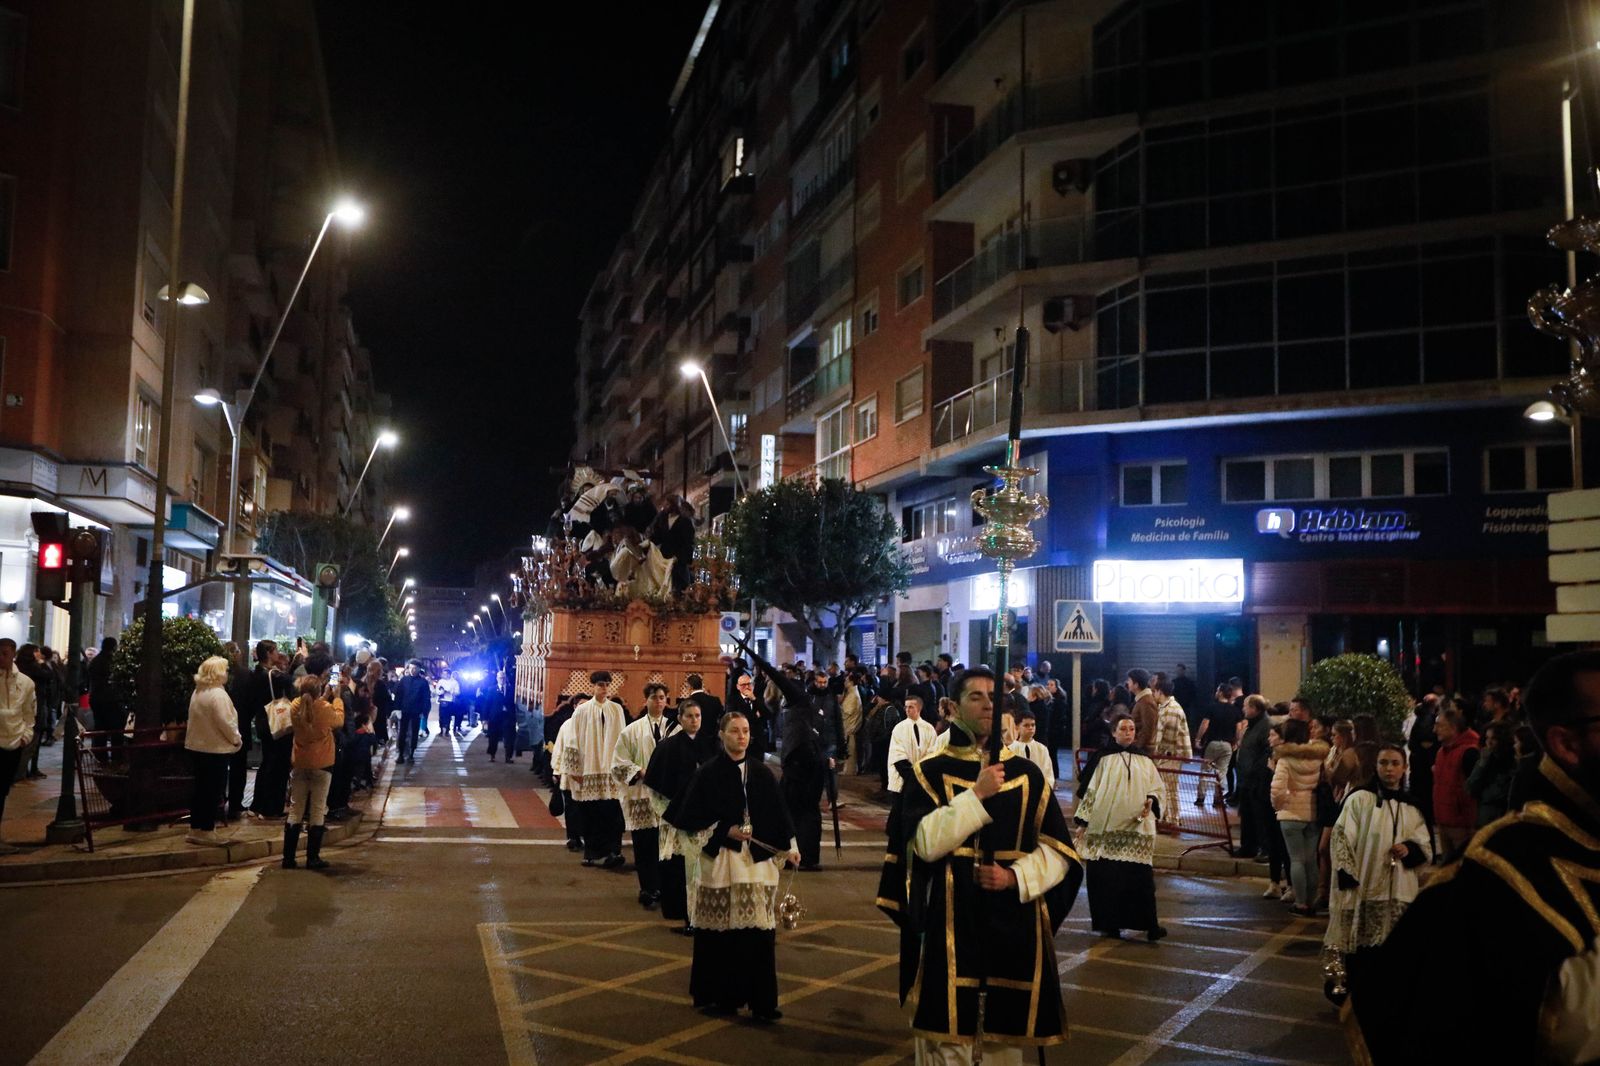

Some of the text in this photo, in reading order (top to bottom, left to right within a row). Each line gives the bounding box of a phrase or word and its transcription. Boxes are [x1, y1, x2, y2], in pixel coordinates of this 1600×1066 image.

[1486, 505, 1548, 518] Logopedi
[1300, 508, 1419, 532] Háblam
[1131, 530, 1229, 542] Medicina de Familia
[1300, 531, 1335, 543] Centro
[1097, 563, 1239, 599] Phonika
